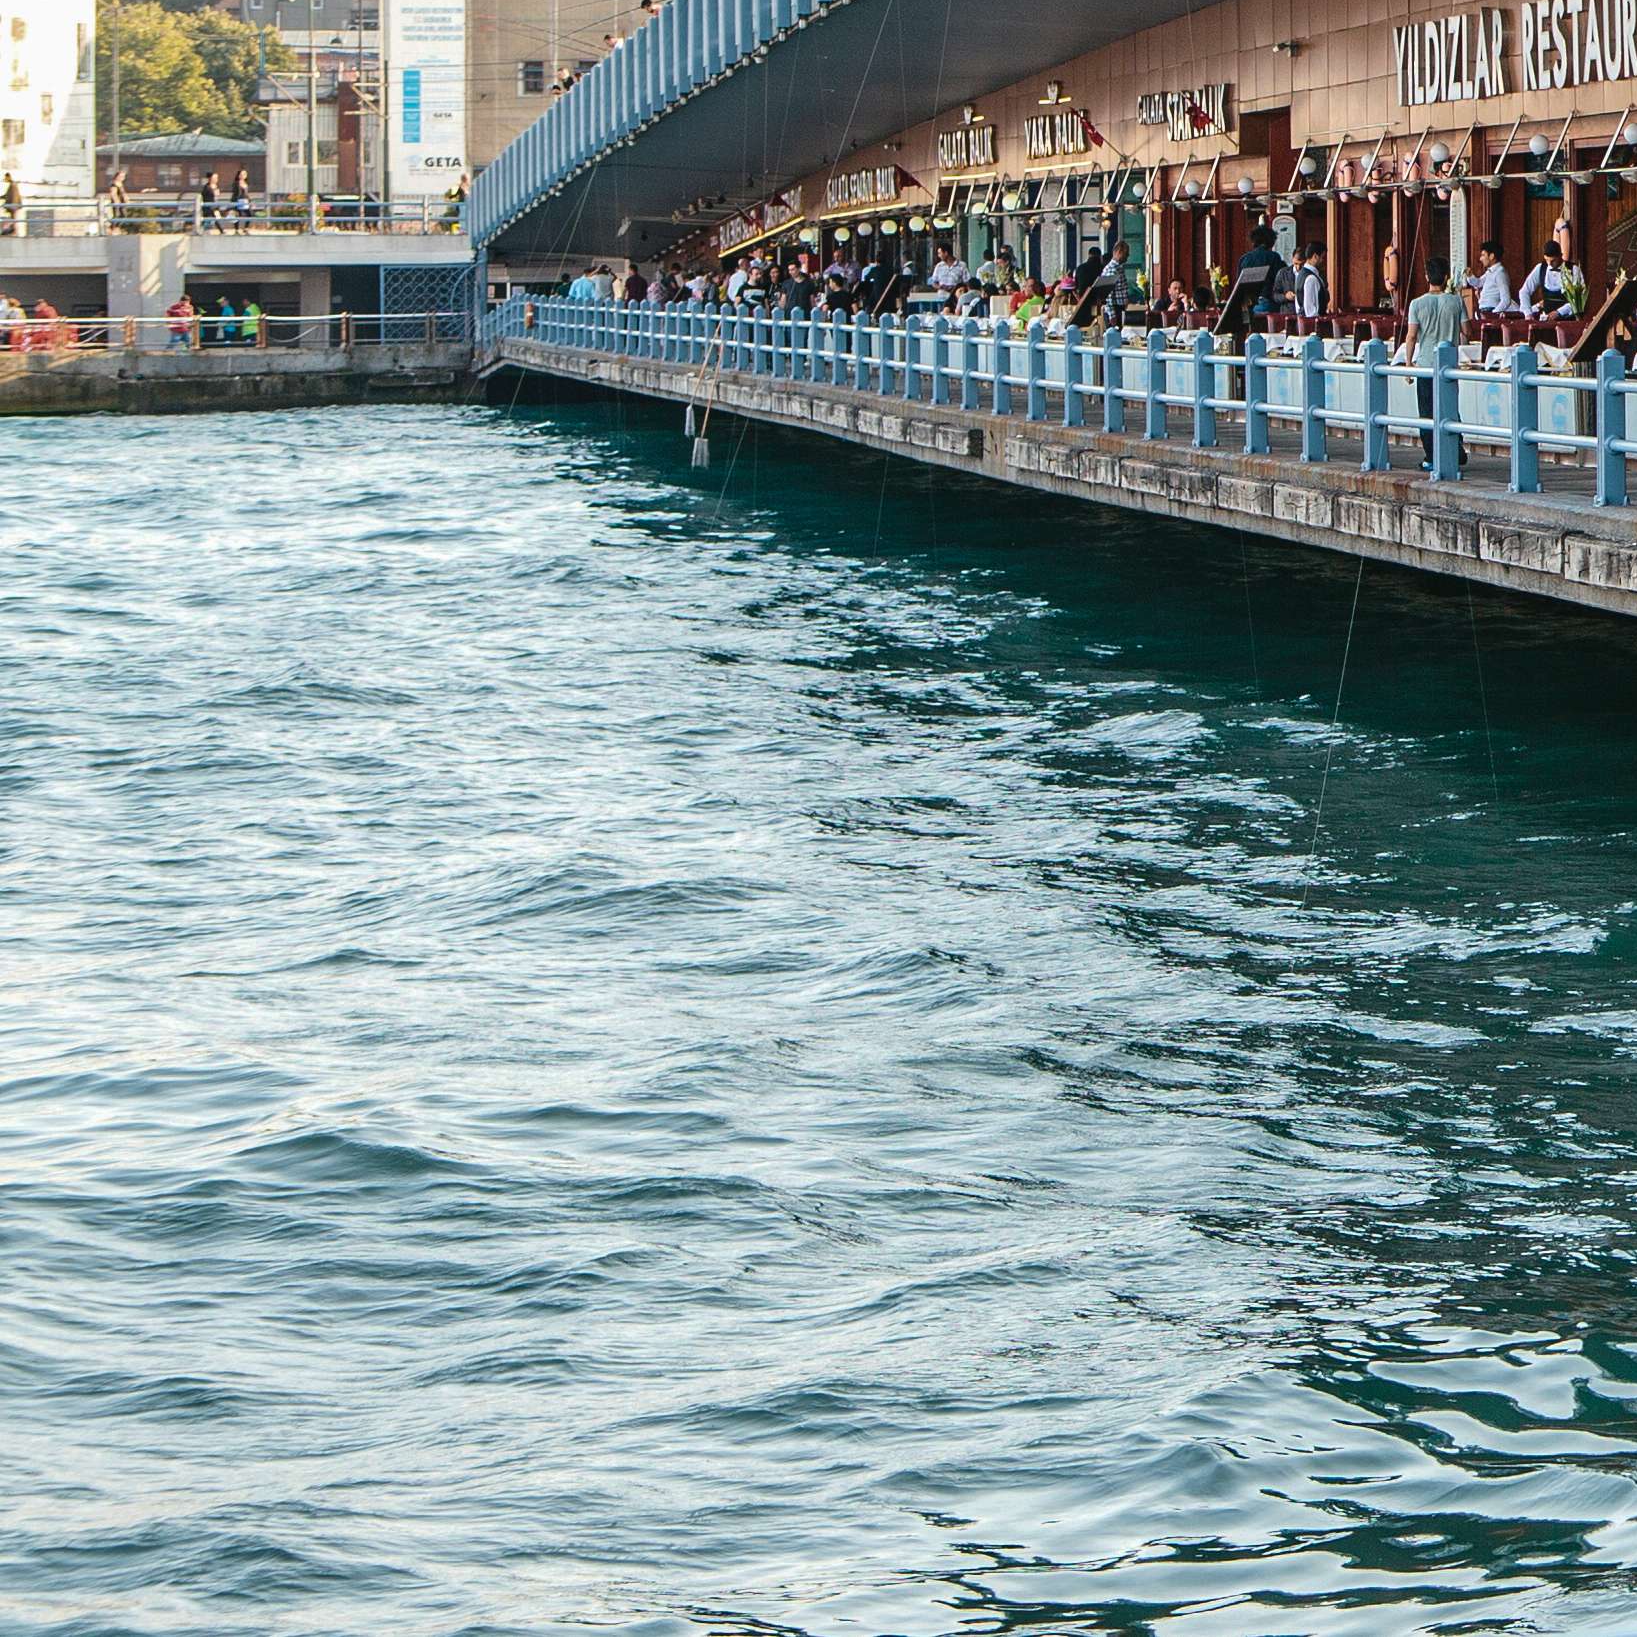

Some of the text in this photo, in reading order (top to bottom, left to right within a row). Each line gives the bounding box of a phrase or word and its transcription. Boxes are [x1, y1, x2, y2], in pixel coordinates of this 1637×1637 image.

[1393, 6, 1505, 107] YILDIZLAR
[1055, 110, 1087, 156] BALIK
[1136, 95, 1164, 125] GALATA
[424, 156, 462, 168] GETA
[938, 125, 994, 171] GALATA BALIK
